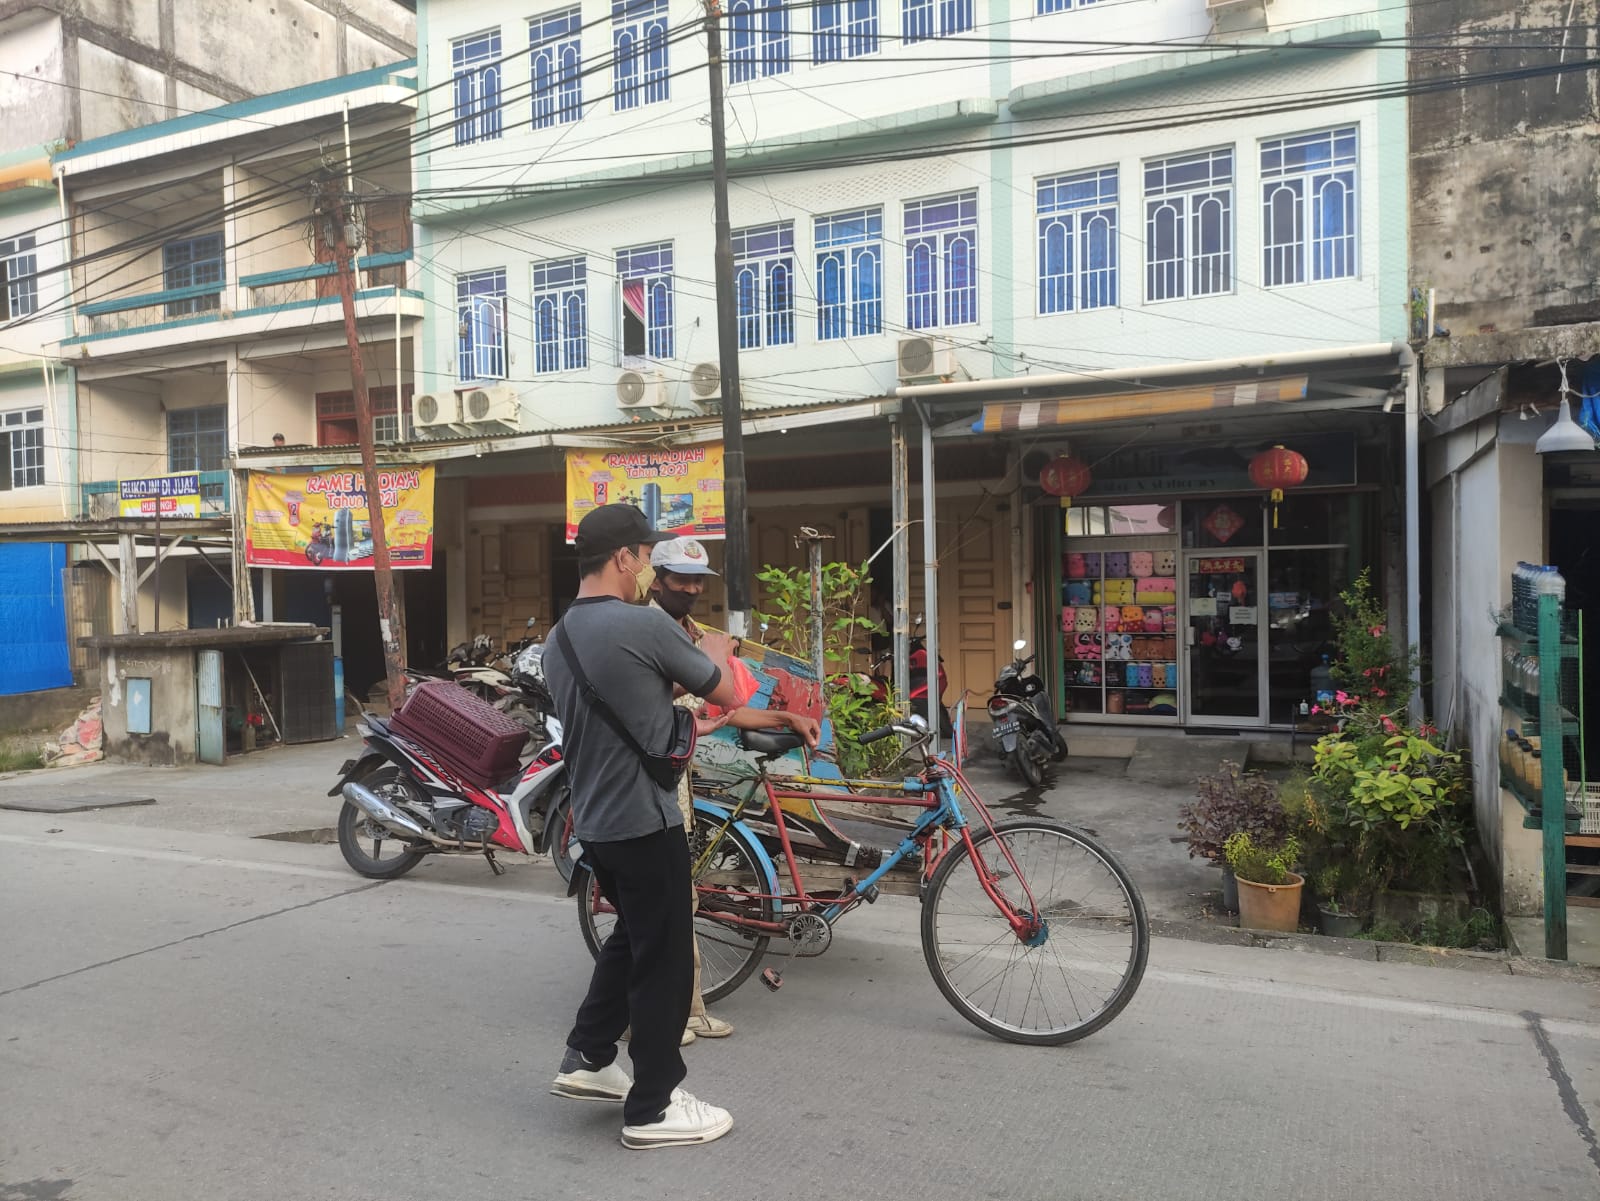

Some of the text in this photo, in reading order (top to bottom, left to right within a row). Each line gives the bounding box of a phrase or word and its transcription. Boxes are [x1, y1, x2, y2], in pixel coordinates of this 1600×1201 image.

[608, 447, 705, 467] RAME HADIAH
[660, 463, 688, 476] 2021
[121, 477, 196, 498] RUKO INI DI JUAL
[307, 471, 419, 493] RAME HDIAH
[597, 484, 604, 495] 2
[142, 500, 172, 511] HUBNGI
[327, 491, 397, 508] Tahun 21
[290, 504, 297, 516] 2
